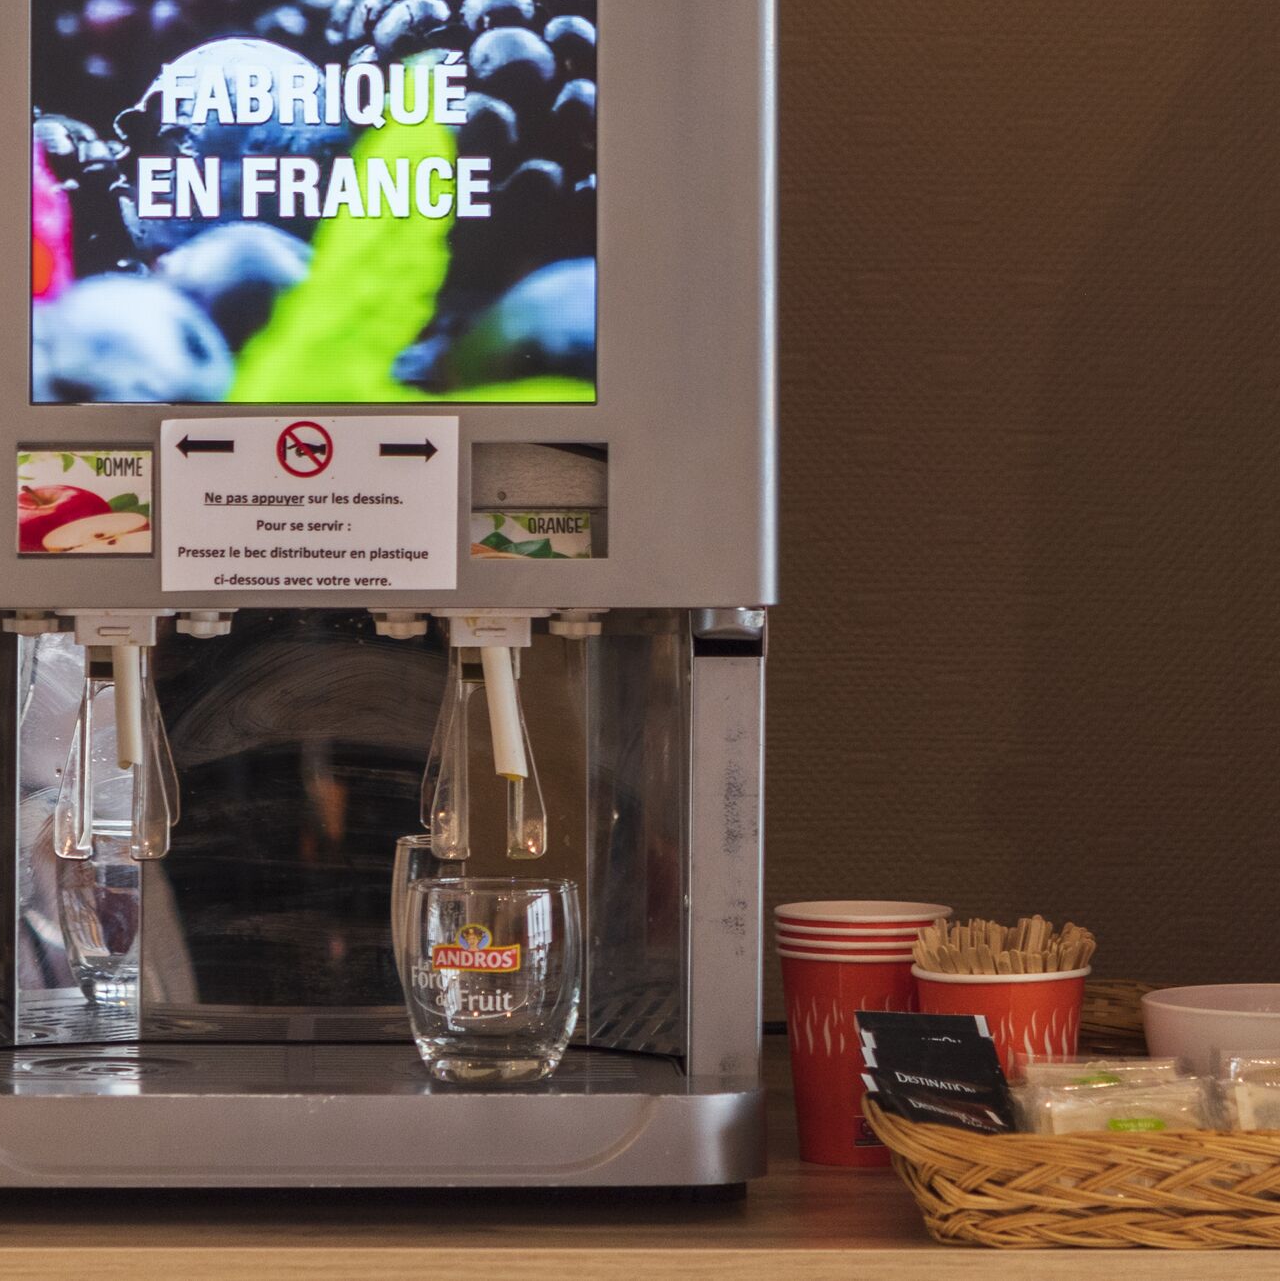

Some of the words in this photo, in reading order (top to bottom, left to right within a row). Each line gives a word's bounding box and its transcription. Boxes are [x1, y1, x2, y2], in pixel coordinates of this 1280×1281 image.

[160, 50, 470, 130] FABRIQUÉ
[137, 156, 220, 218] EN
[241, 156, 492, 218] FRANCE
[95, 456, 144, 477] POMME
[204, 491, 222, 505] Ne
[226, 494, 249, 506] pas
[251, 494, 305, 507] appuyer
[307, 493, 328, 505] sur
[331, 492, 350, 505] les
[352, 492, 404, 506] dessins.
[256, 519, 286, 531] Pour
[290, 521, 304, 531] se
[307, 520, 344, 532] servir
[527, 517, 584, 535] ORANGE
[177, 546, 226, 559] Pressez
[229, 546, 241, 558] le
[244, 546, 267, 559] bec
[270, 546, 346, 559] distributeur
[349, 549, 366, 559] en
[369, 547, 429, 562] plastique
[213, 574, 280, 586] ci-dessous
[283, 576, 313, 586] avec
[316, 575, 351, 586] votre
[353, 576, 392, 587] verre.
[435, 950, 514, 968] ANDROS
[459, 989, 514, 1012] Fruit
